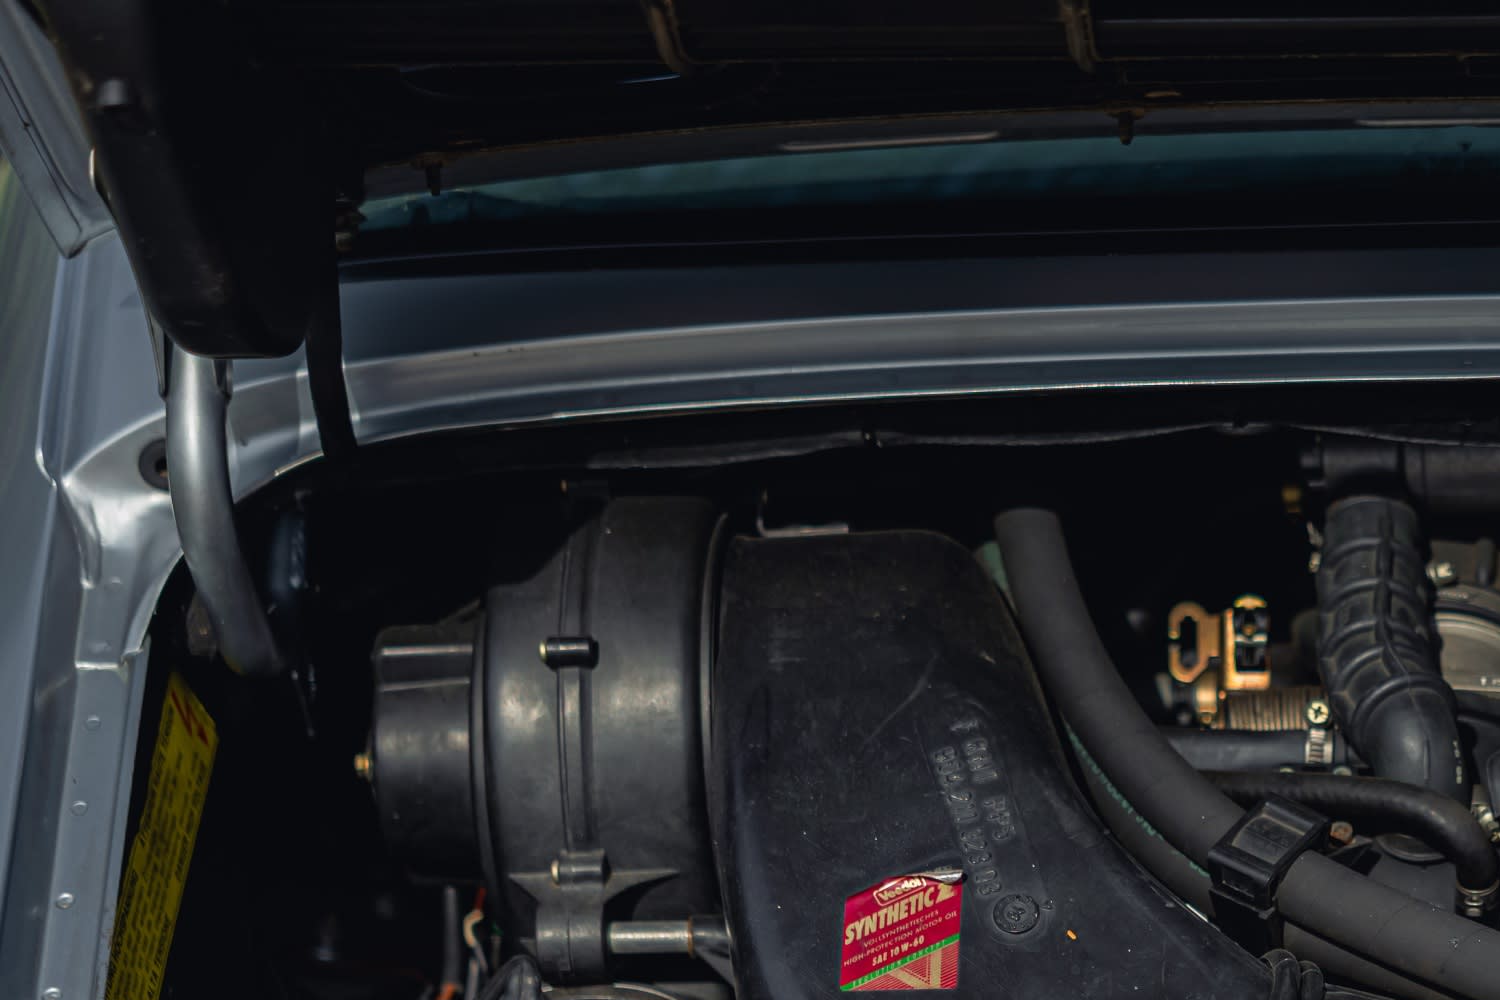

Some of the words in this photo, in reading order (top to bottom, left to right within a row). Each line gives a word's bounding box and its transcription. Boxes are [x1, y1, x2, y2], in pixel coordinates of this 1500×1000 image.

[877, 877, 923, 901] Veedol
[844, 886, 935, 946] SYNTHETIC
[863, 909, 939, 948] VOLLSYNTHETISCHES
[843, 930, 913, 967] HIGH-PROTECTION
[915, 917, 943, 934] MOTOR
[872, 952, 888, 967] SAE
